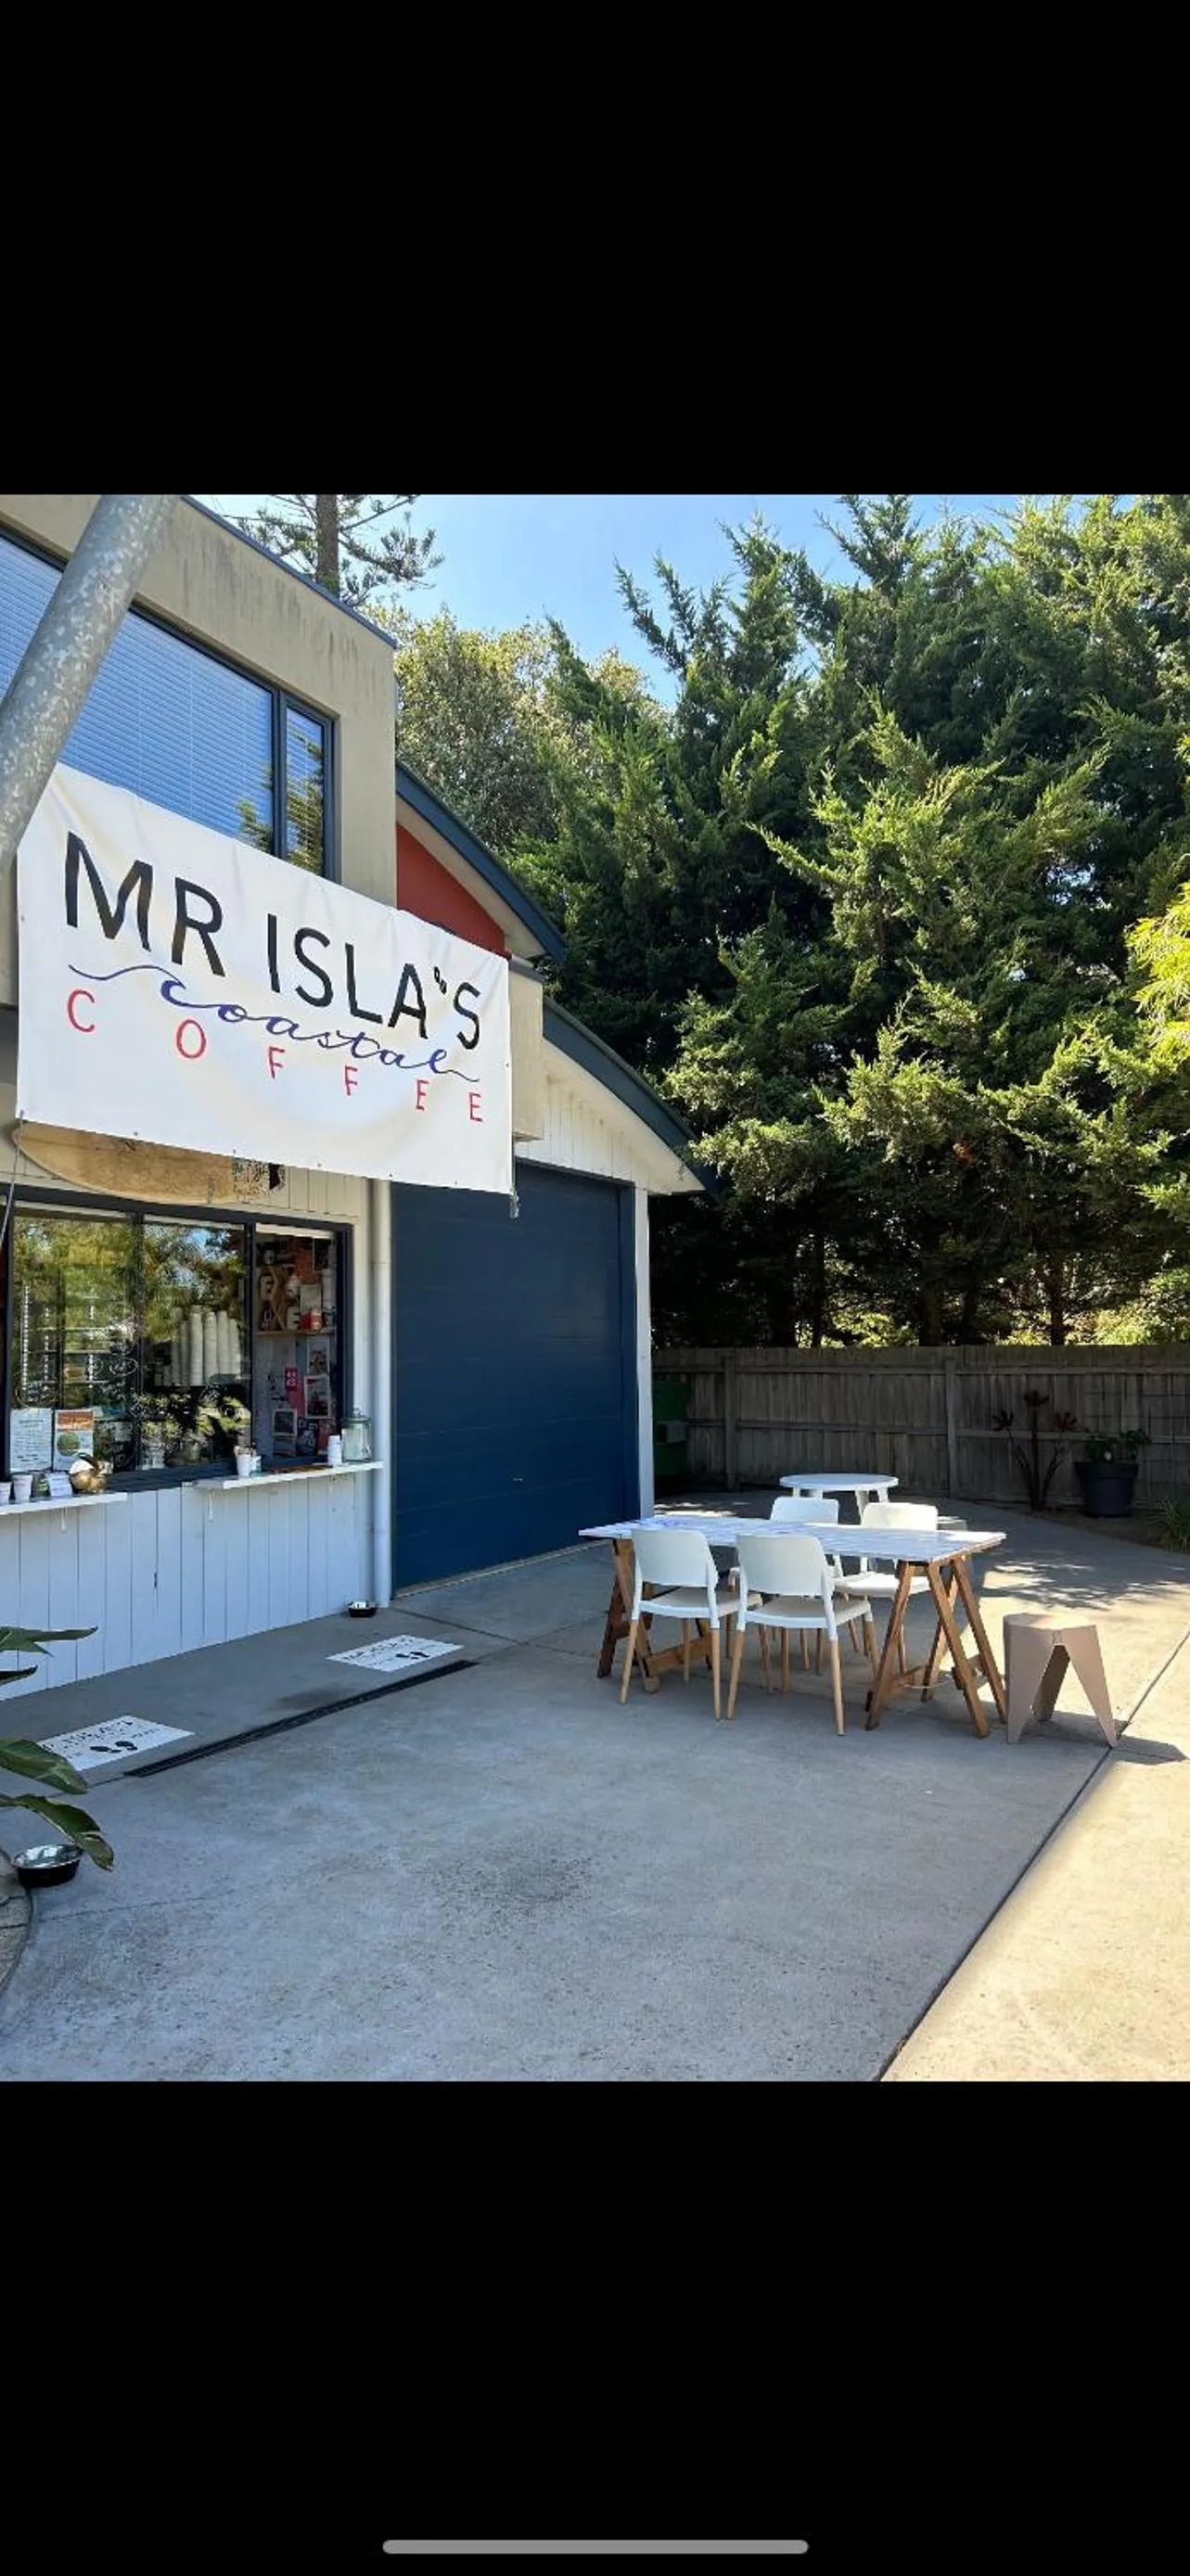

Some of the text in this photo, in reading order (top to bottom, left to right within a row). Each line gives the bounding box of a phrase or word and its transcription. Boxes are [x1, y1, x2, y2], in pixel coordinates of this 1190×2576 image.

[65, 831, 225, 976] MR
[67, 989, 483, 1123] COFFEE
[70, 964, 480, 1082] coastal
